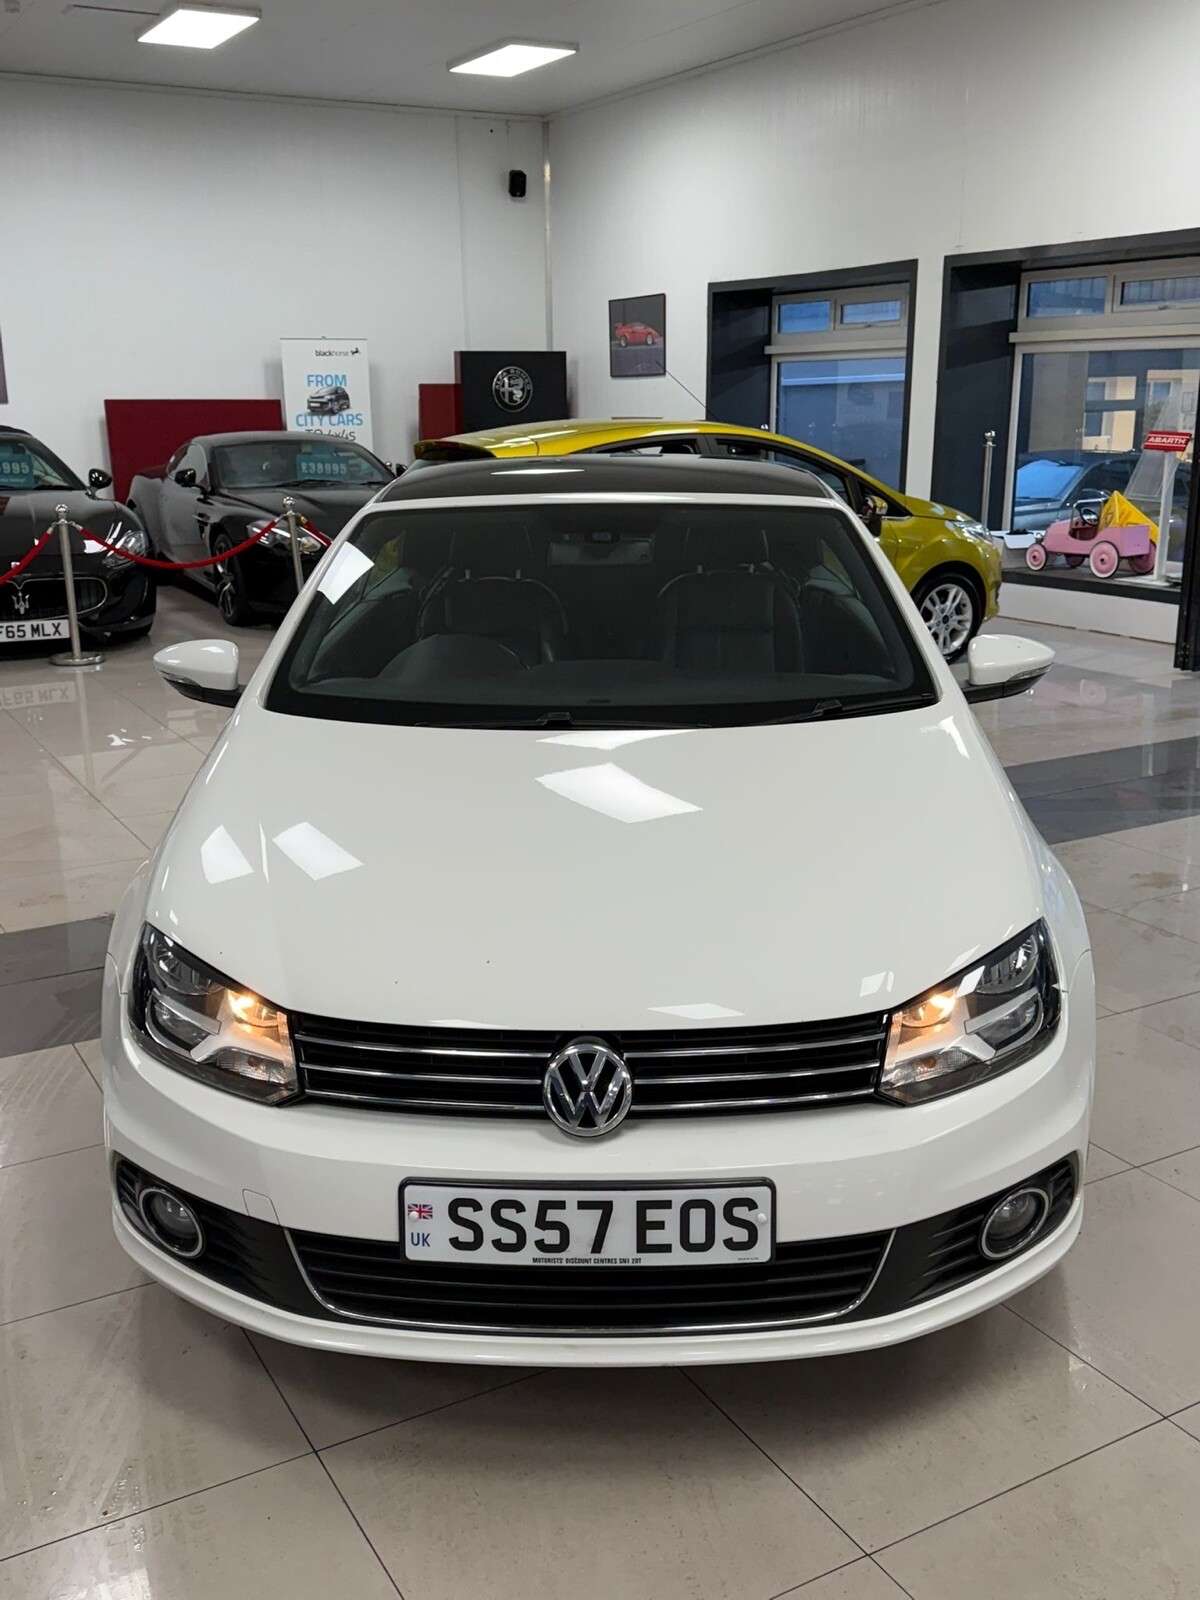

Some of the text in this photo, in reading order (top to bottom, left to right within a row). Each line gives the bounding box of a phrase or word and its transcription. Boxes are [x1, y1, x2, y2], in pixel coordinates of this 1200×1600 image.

[307, 374, 347, 387] FROM
[296, 413, 364, 426] CITY CARS
[1148, 436, 1187, 445] ABARTH
[0, 462, 30, 474] 995
[31, 622, 62, 638] MLX
[448, 1197, 759, 1254] SS57 EOS
[410, 1231, 430, 1247] UK
